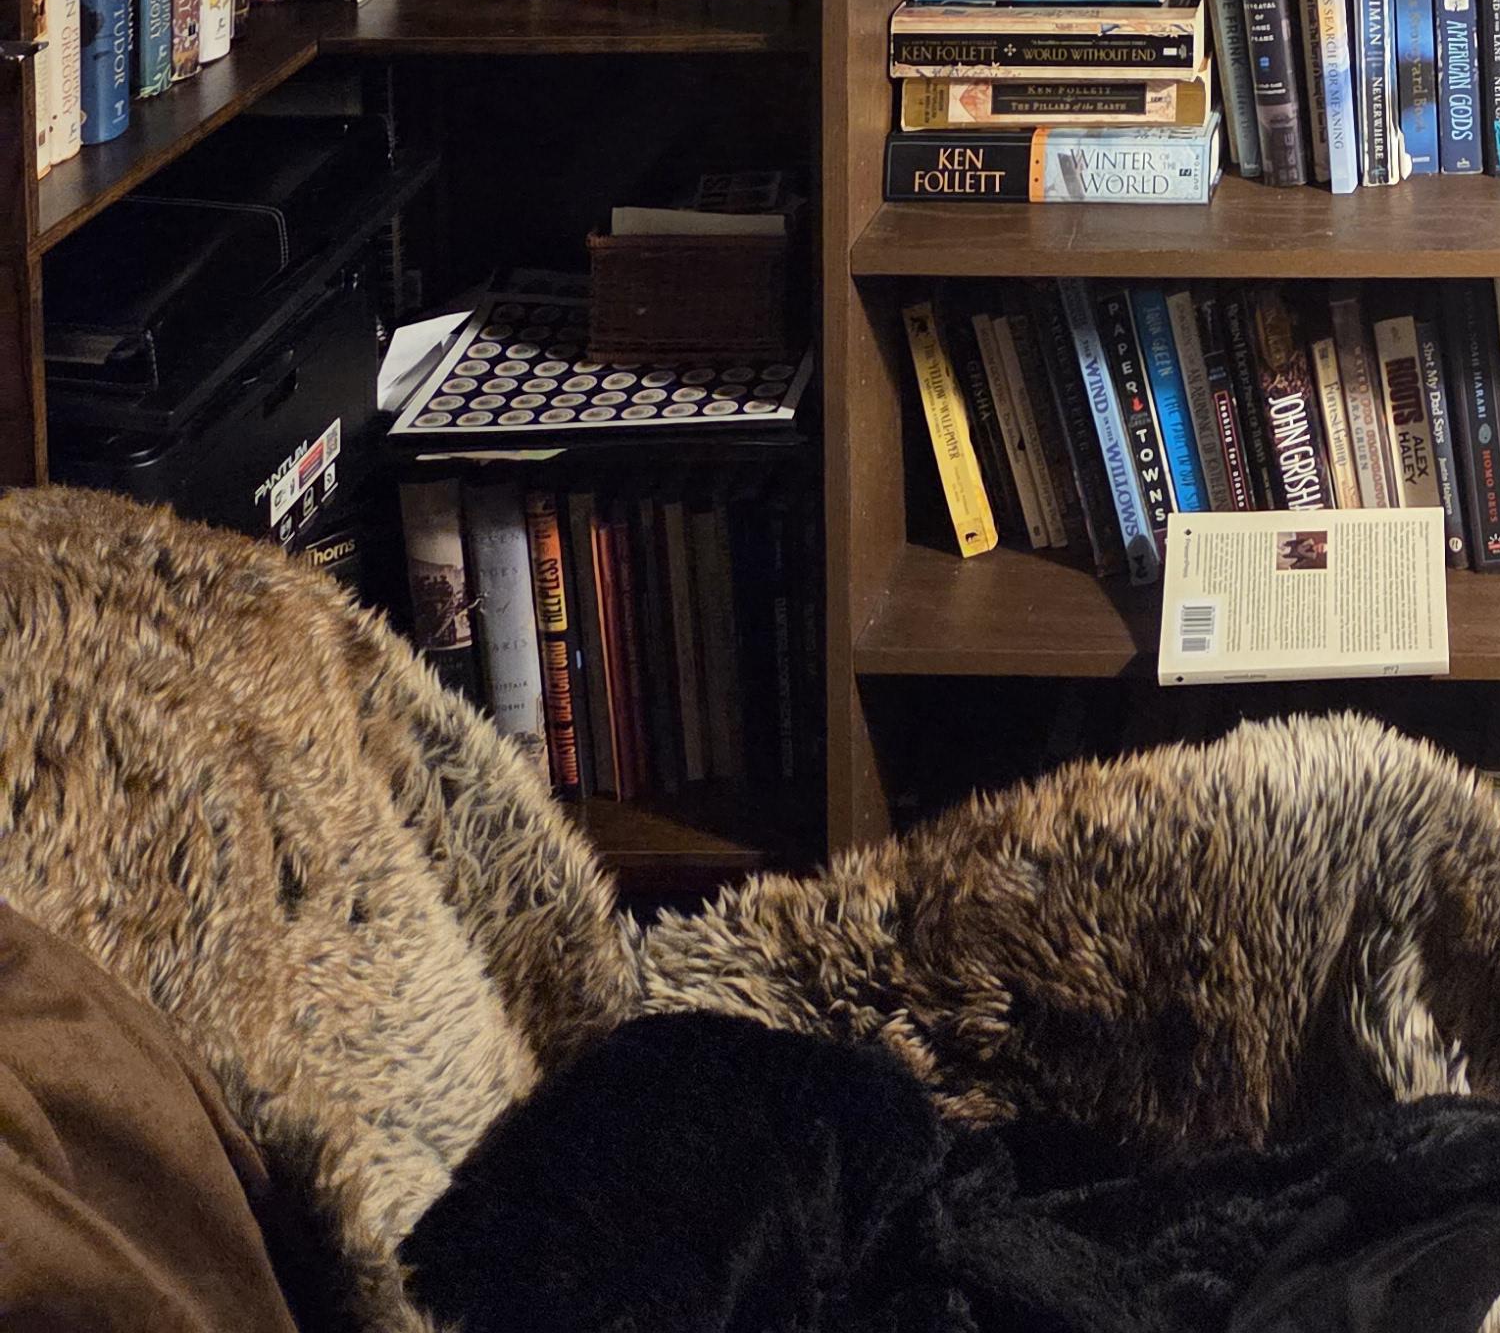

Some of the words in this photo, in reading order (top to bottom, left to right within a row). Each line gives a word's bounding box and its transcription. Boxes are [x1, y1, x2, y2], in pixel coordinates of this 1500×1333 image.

[1024, 47, 1068, 61] WORLD
[1071, 47, 1128, 60] WITHOUT
[1132, 48, 1156, 60] END
[939, 148, 983, 169] KEN
[1071, 149, 1155, 169] WINTER
[915, 171, 1005, 193] FOLLETT
[1081, 172, 1169, 195] WORLD
[1385, 357, 1424, 425] ROOTS
[1109, 303, 1138, 393] PAPER
[1136, 430, 1166, 523] TOWNS
[1397, 432, 1417, 485] HALEY
[1411, 435, 1428, 477] ALEX
